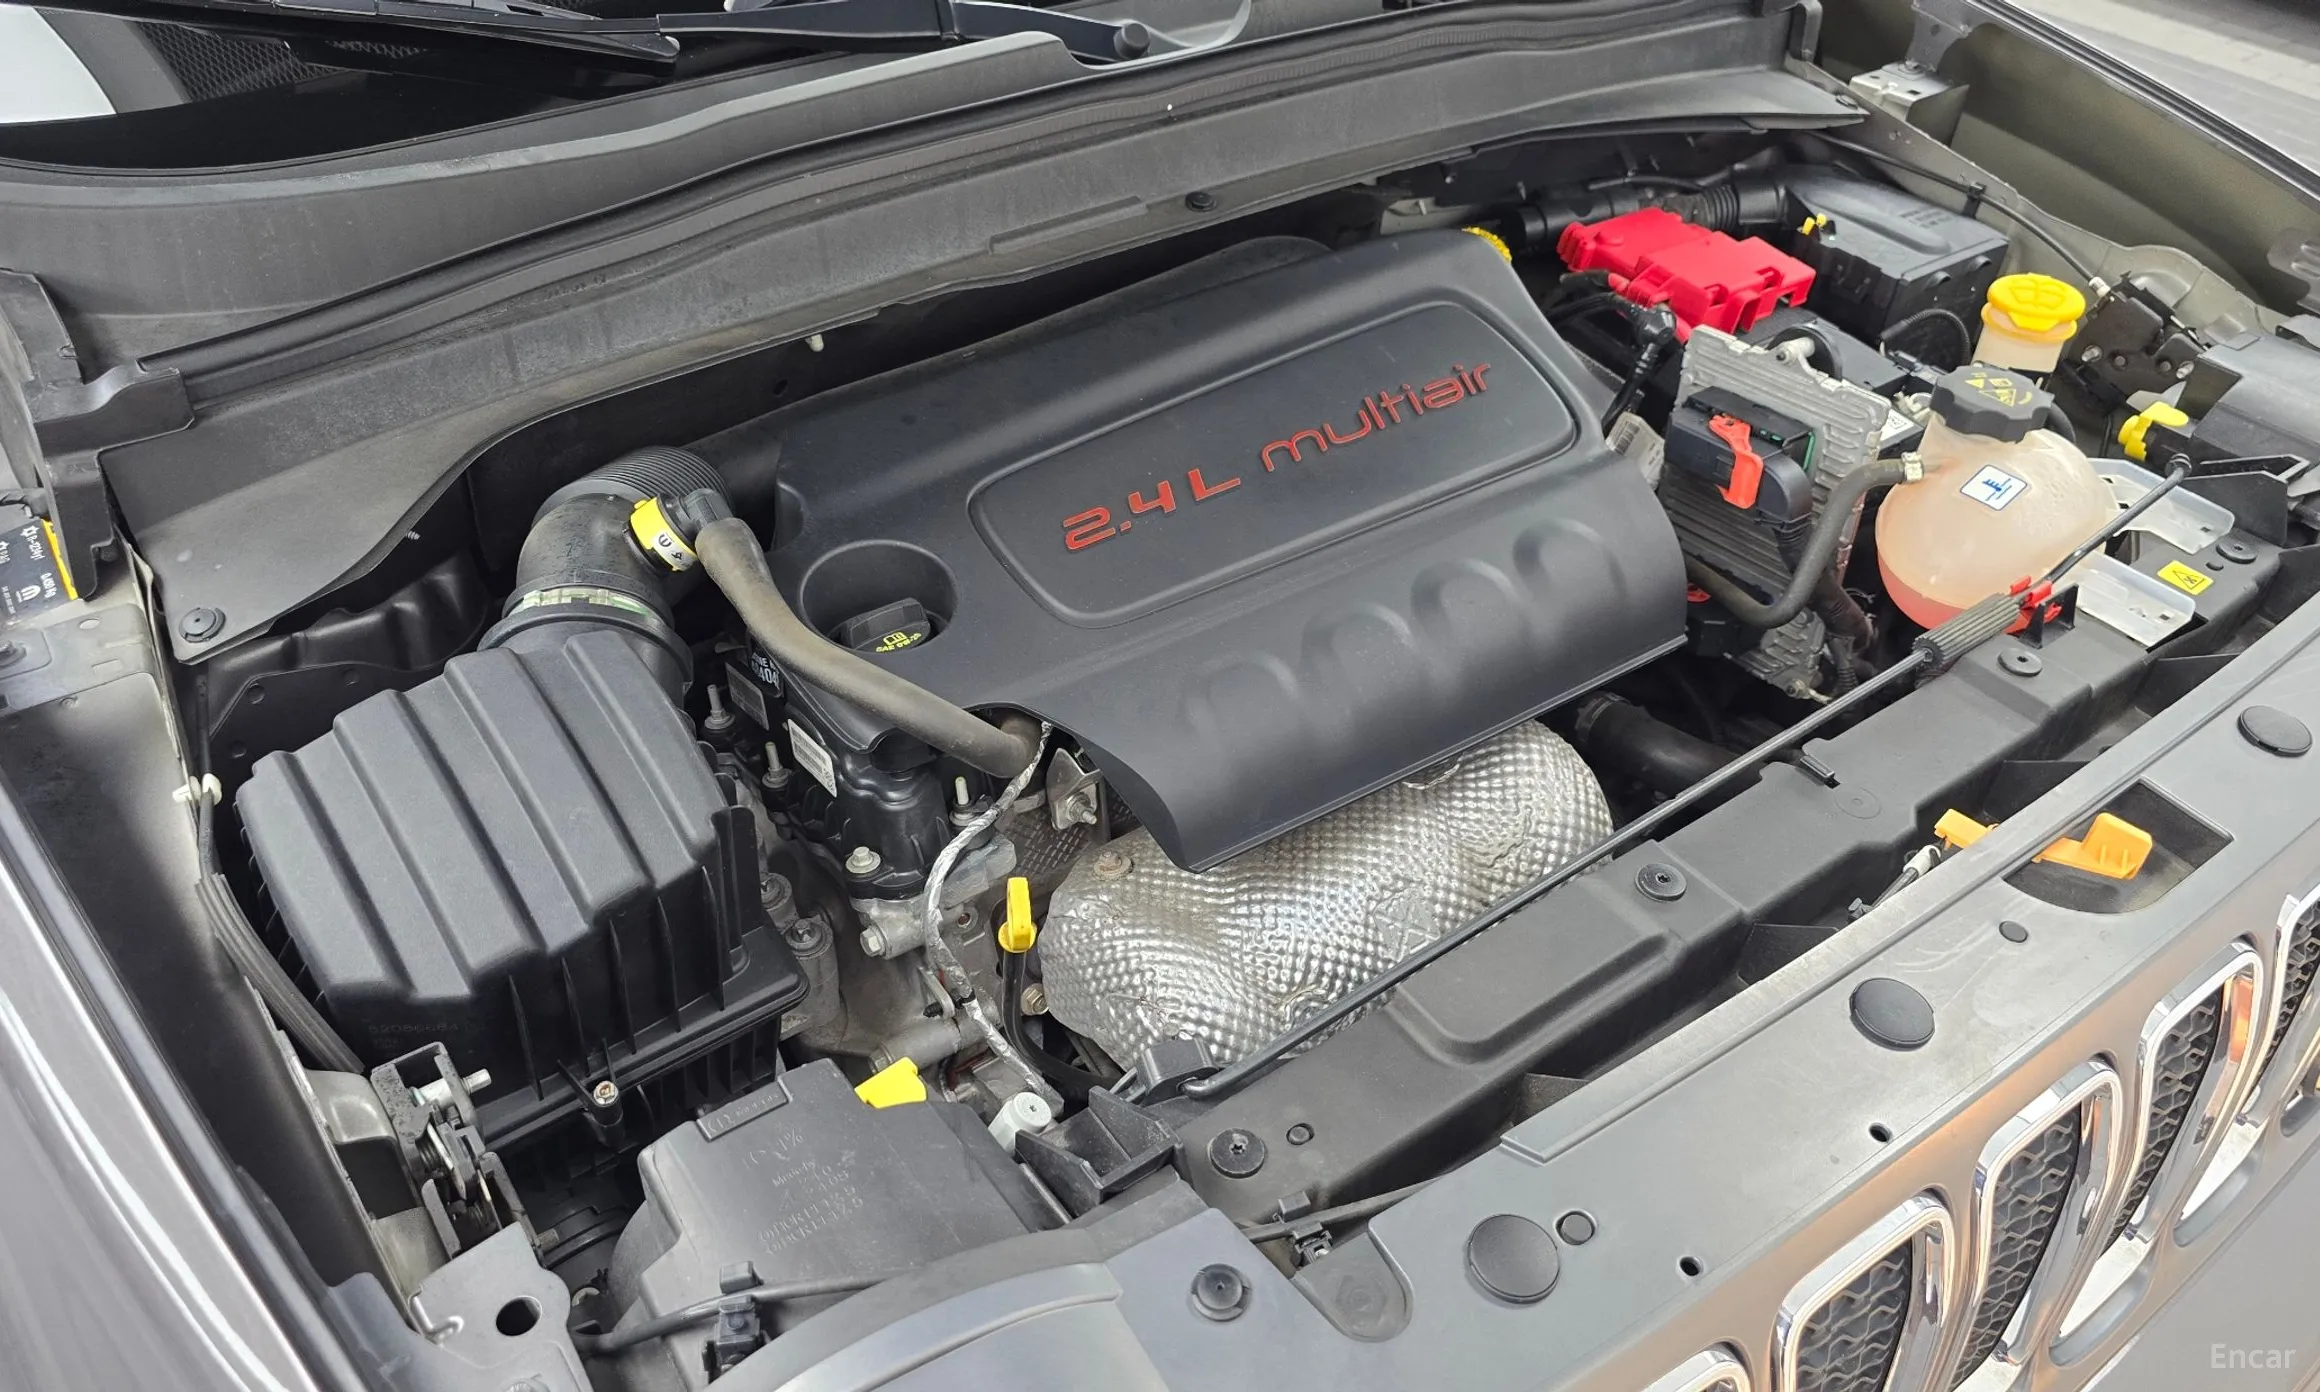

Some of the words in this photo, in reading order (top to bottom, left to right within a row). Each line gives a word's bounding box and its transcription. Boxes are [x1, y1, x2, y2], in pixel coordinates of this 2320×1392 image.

[1063, 479, 1177, 552] 2.4
[1187, 466, 1242, 502] L
[1259, 362, 1491, 473] multiair
